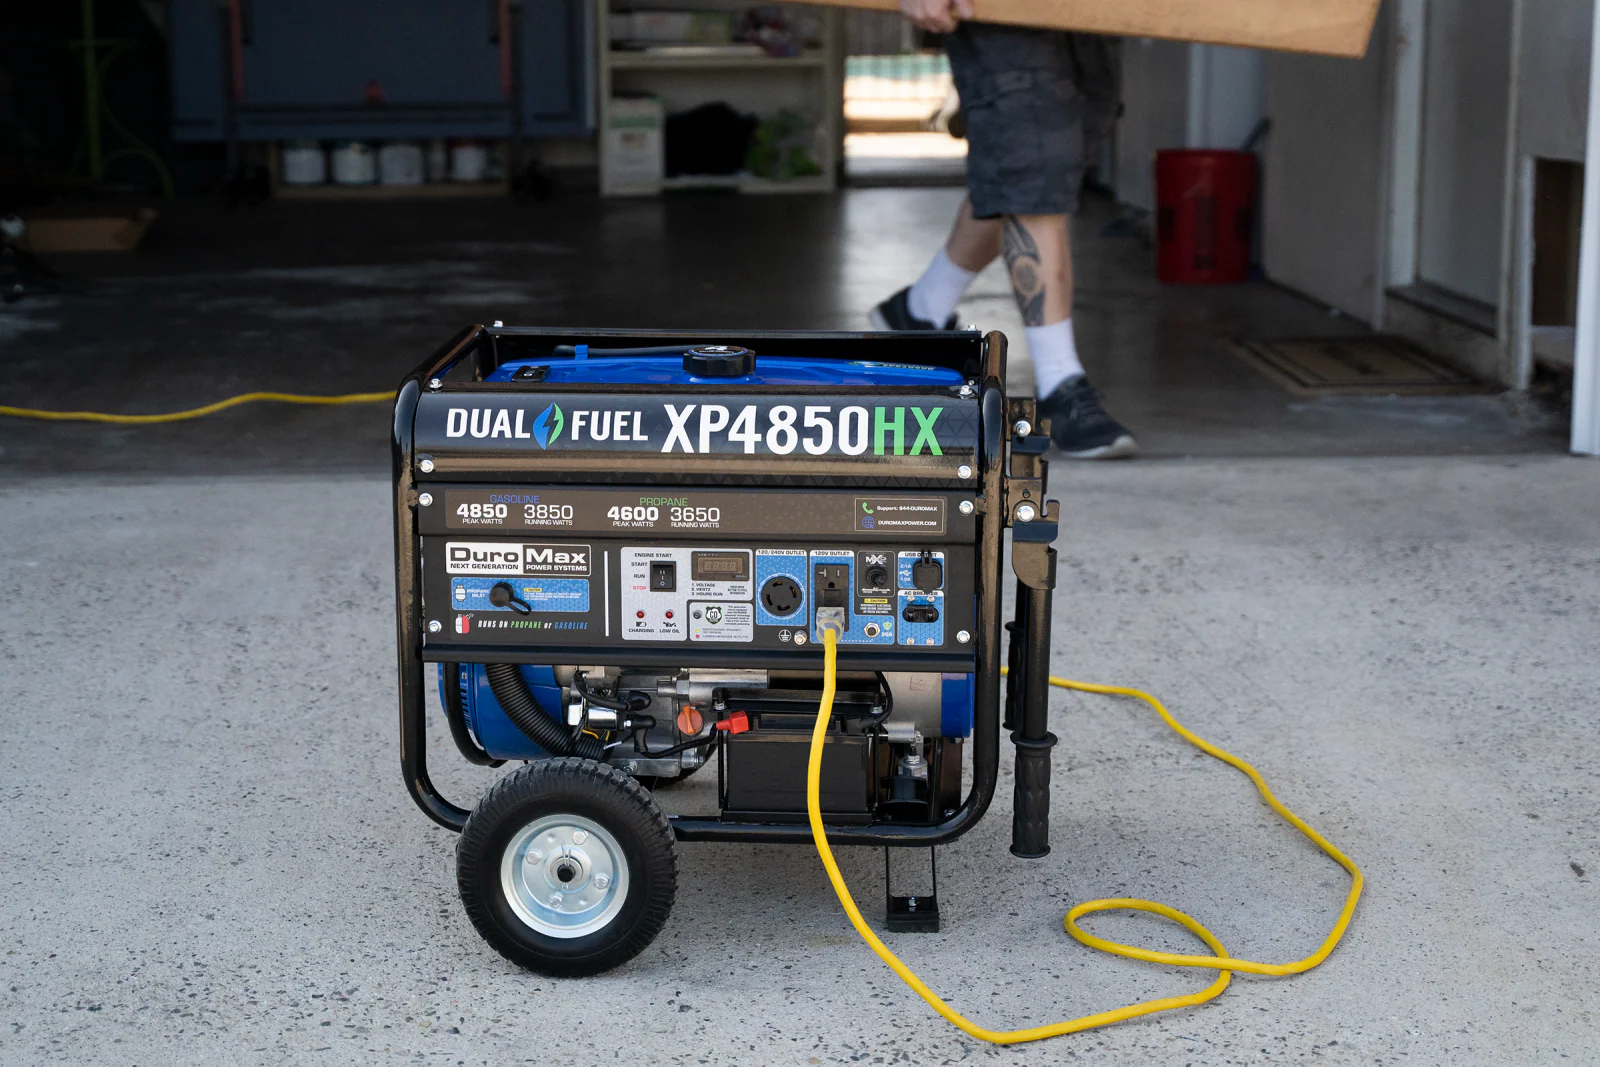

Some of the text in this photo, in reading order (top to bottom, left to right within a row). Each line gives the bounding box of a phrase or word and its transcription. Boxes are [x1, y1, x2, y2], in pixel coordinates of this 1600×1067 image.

[446, 404, 944, 456] DUAL FUEL XP4850HX
[490, 494, 540, 504] GASOLINE
[639, 497, 688, 507] PROPANE
[456, 503, 574, 519] 4850 3850
[607, 506, 720, 522] 4600 3650
[709, 610, 718, 619] CO
[477, 620, 497, 628] RUNS
[498, 620, 509, 628] ON
[510, 620, 542, 629] PROPANE
[554, 622, 588, 630] GASOLINE
